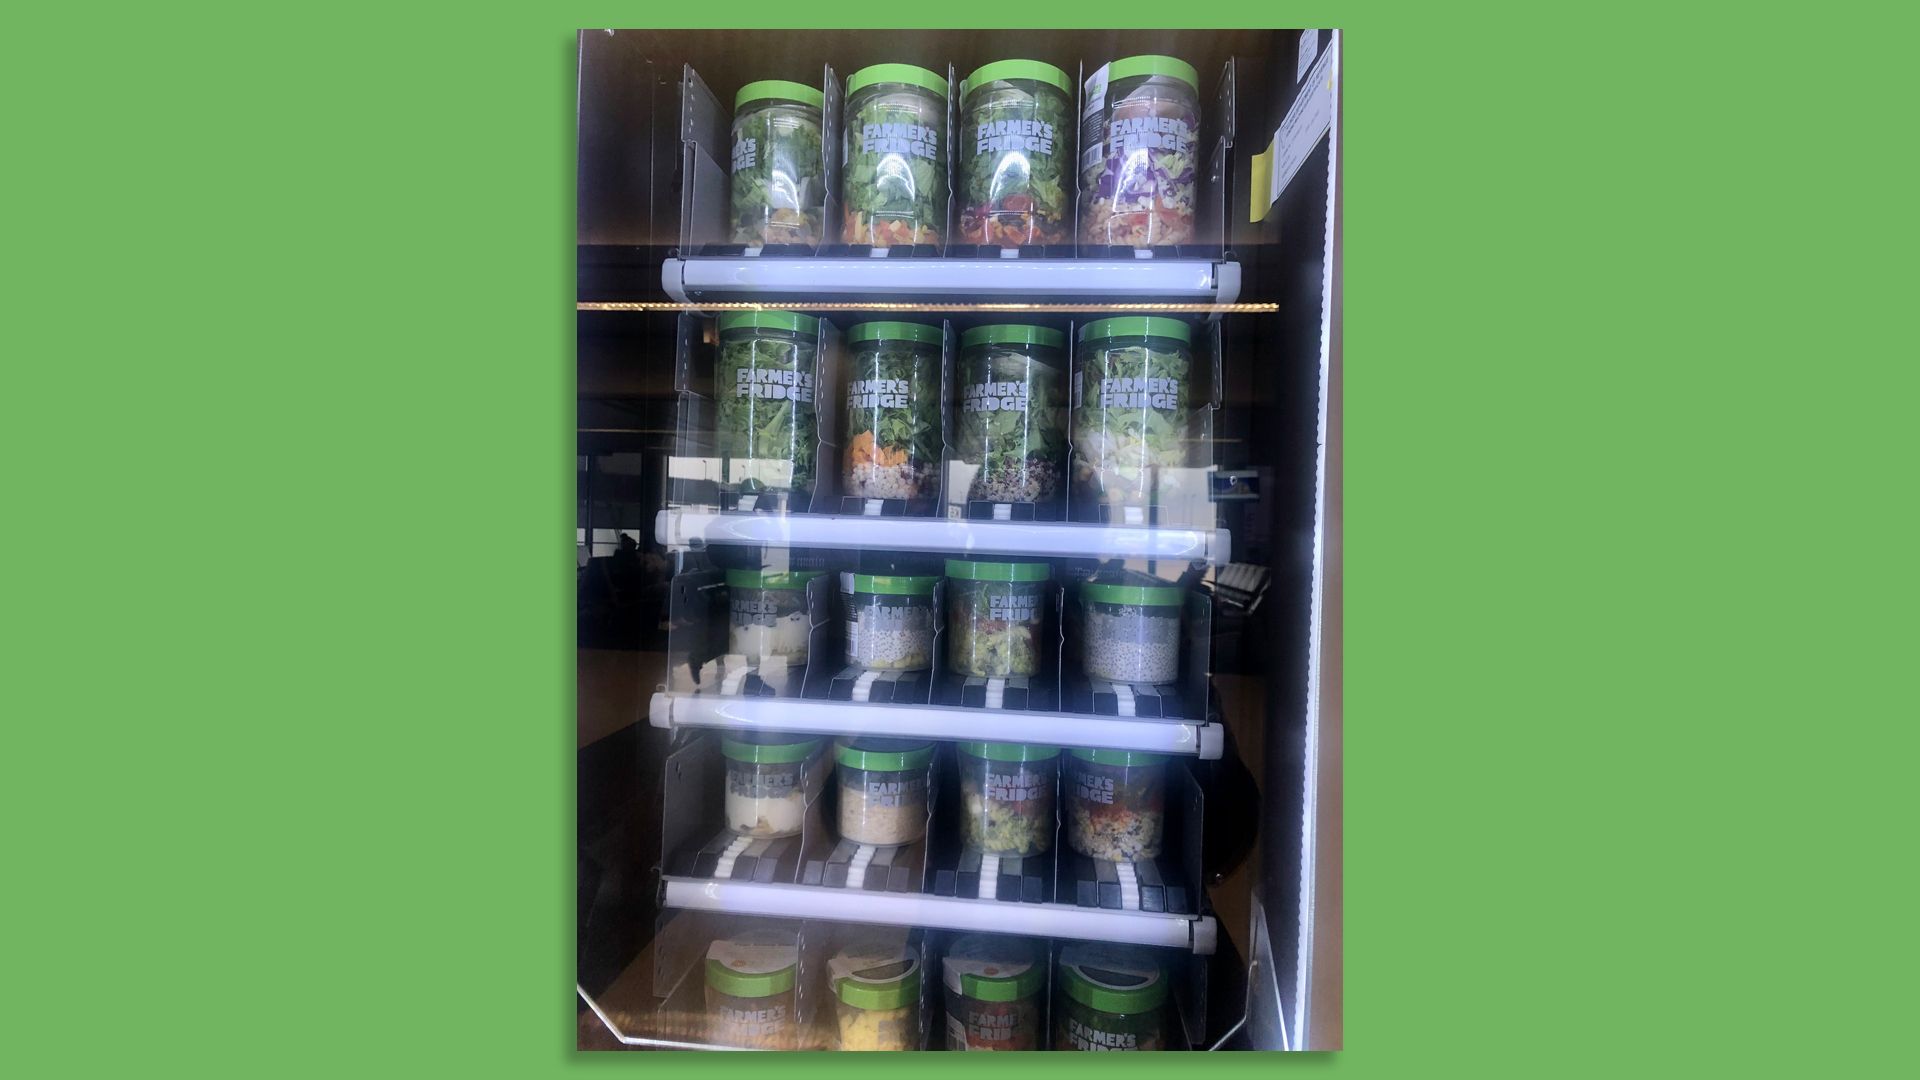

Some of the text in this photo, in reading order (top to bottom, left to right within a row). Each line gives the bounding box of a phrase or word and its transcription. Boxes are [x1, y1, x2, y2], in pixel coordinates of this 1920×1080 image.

[862, 123, 937, 145] FARMER'S
[977, 119, 1053, 139] FARMER'S
[862, 138, 937, 160] FRIDGE
[976, 134, 1052, 155] FRIDGE
[1110, 131, 1188, 154] FRIDGE
[736, 368, 813, 388] FARMER'S
[1101, 376, 1178, 394] FARMER'S
[736, 383, 813, 403] FRIDGE
[963, 380, 1029, 399] FARMER'S
[963, 396, 1028, 413] FRIDGE
[1101, 393, 1178, 410] FRIDGE
[1070, 1018, 1136, 1048] FARMER'S
